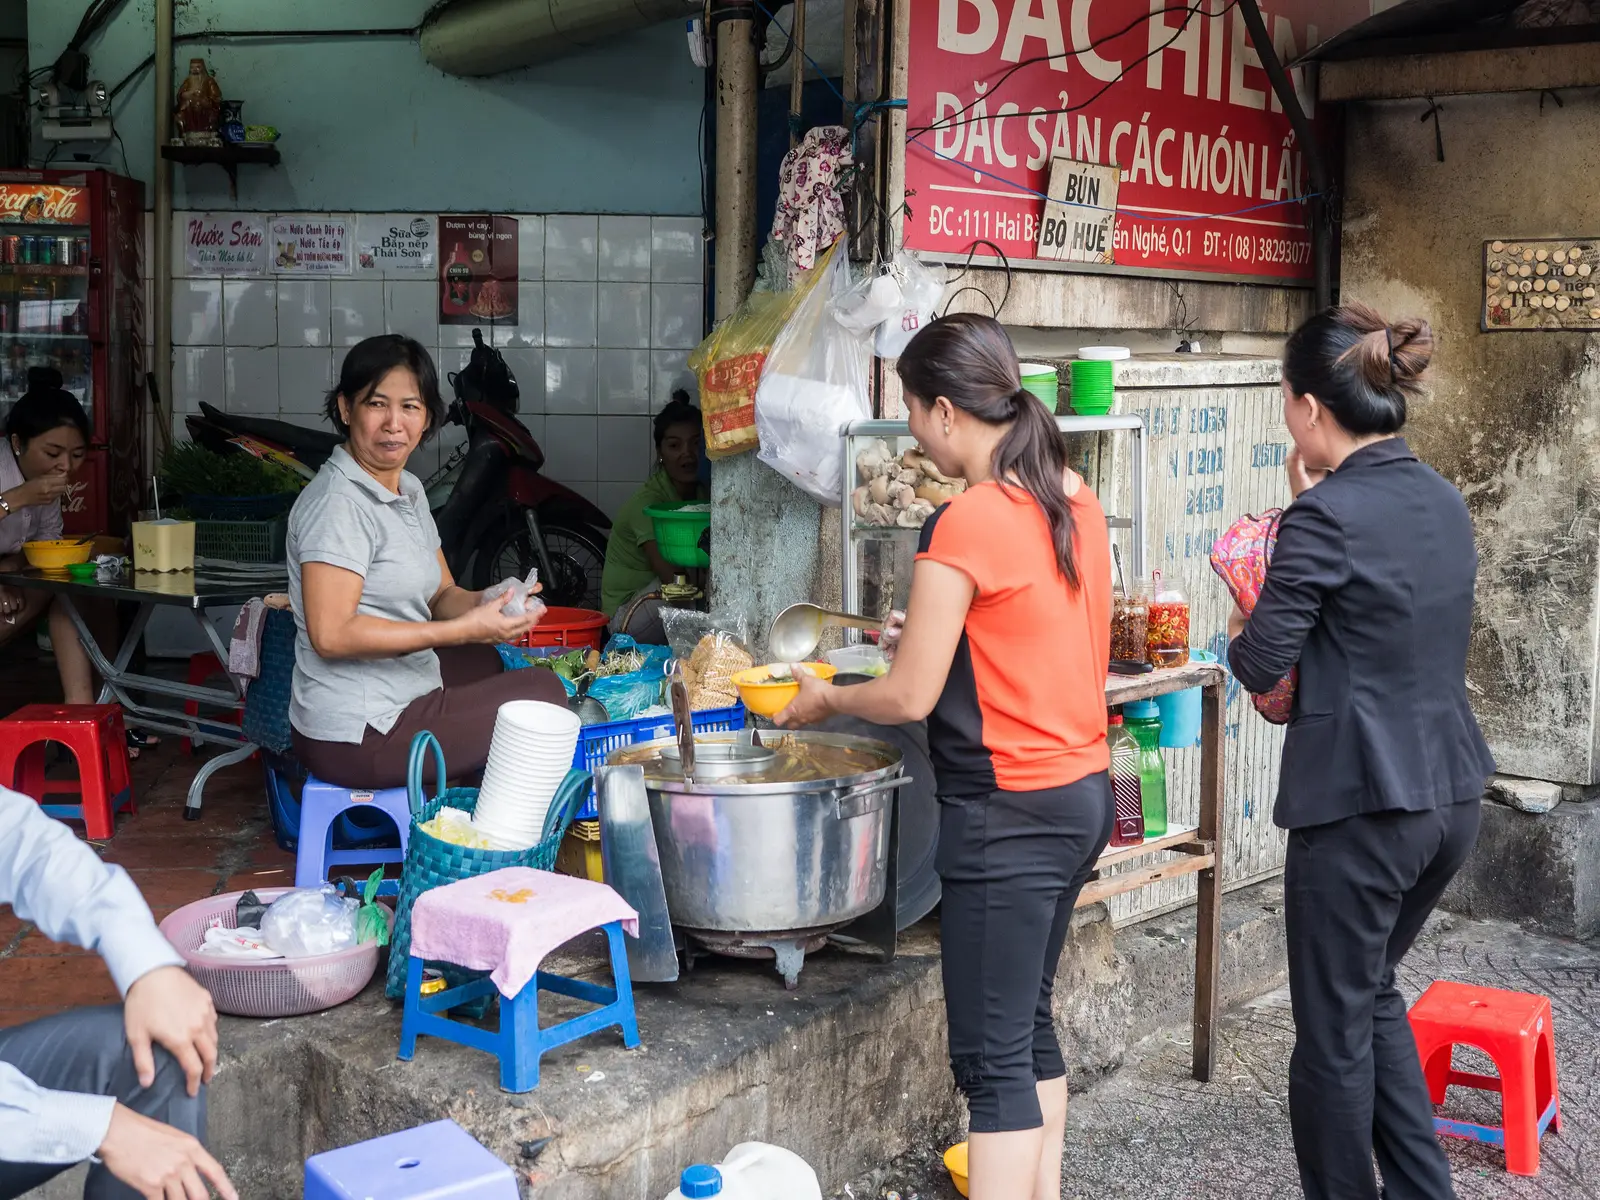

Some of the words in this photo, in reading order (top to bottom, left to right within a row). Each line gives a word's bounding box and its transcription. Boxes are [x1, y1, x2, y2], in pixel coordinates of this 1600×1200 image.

[932, 81, 1019, 183] ĐẶC
[1026, 91, 1101, 171] SẢN
[1109, 112, 1176, 188] CÁC
[1181, 125, 1254, 198] MÓN
[1065, 168, 1100, 206] BÚN
[188, 219, 225, 247] Nước
[229, 220, 263, 247] Sâm
[389, 226, 412, 239] Sữa
[995, 211, 1020, 241] Hai
[1132, 224, 1169, 259] Nghé,
[1172, 227, 1191, 256] Q.1
[1258, 237, 1311, 265] 38293077
[1042, 212, 1067, 248] BÒ
[1073, 214, 1113, 252] HUẾ
[371, 246, 398, 258] Thái
[400, 248, 421, 258] Sơn
